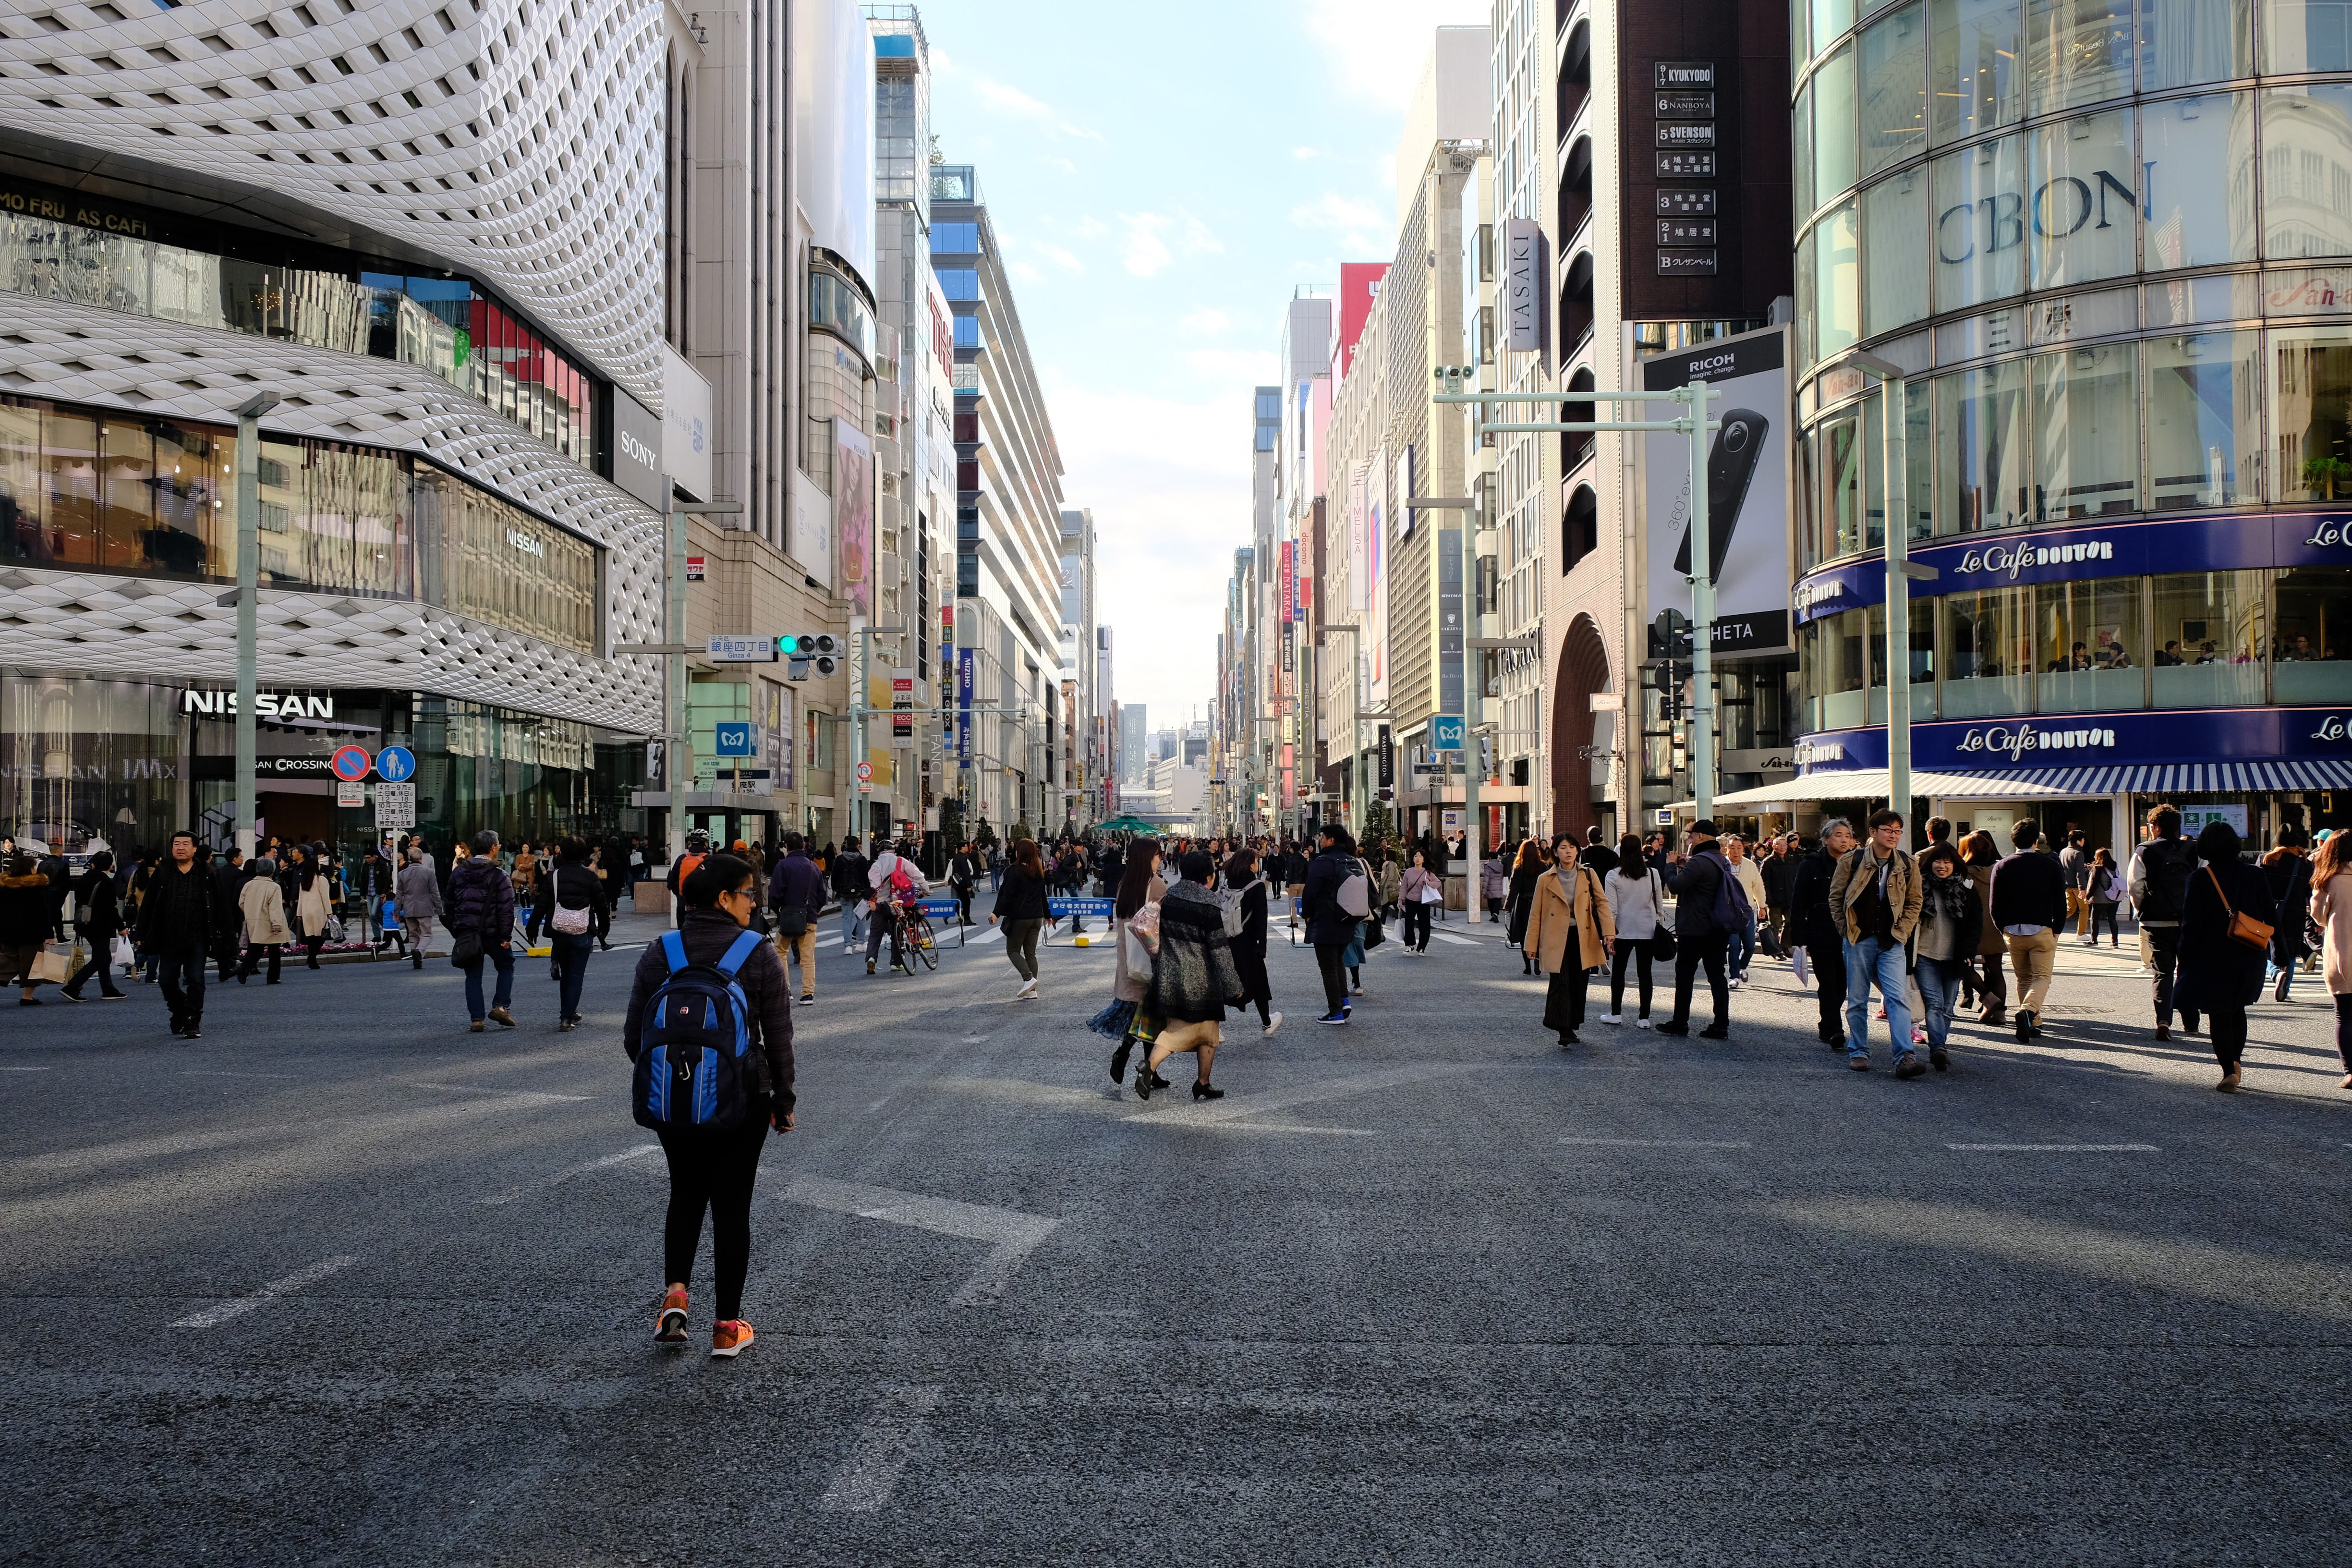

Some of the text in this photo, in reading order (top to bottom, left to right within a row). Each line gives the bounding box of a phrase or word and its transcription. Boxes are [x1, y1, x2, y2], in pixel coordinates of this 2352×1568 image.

[1669, 69, 1710, 82] KYUKYODO
[1659, 99, 1668, 110] 6
[1660, 127, 1711, 140] 5 SVENSON
[1661, 159, 1670, 170] 4
[1661, 197, 1670, 207] 3
[1661, 223, 1669, 231] 2
[1663, 228, 1711, 242] 1 鳩居堂
[1661, 257, 1671, 267] B
[1514, 235, 1529, 336] TASAKI
[1690, 353, 1734, 372] RICOH
[1714, 365, 1736, 374] change.
[693, 415, 708, 435] YKK
[622, 431, 656, 471] SONY
[853, 443, 866, 458] PRADA
[2304, 521, 2340, 547] Le
[507, 528, 543, 559] NISSAN
[1954, 541, 2113, 580] Le Café DOUTOR
[1710, 623, 1753, 641] HETA
[711, 642, 768, 652] 銀座四丁目
[851, 632, 862, 685] GINZA
[2310, 716, 2345, 741] Le
[1956, 724, 2116, 762] Le Café DOUTOR
[931, 735, 941, 779] FANCL
